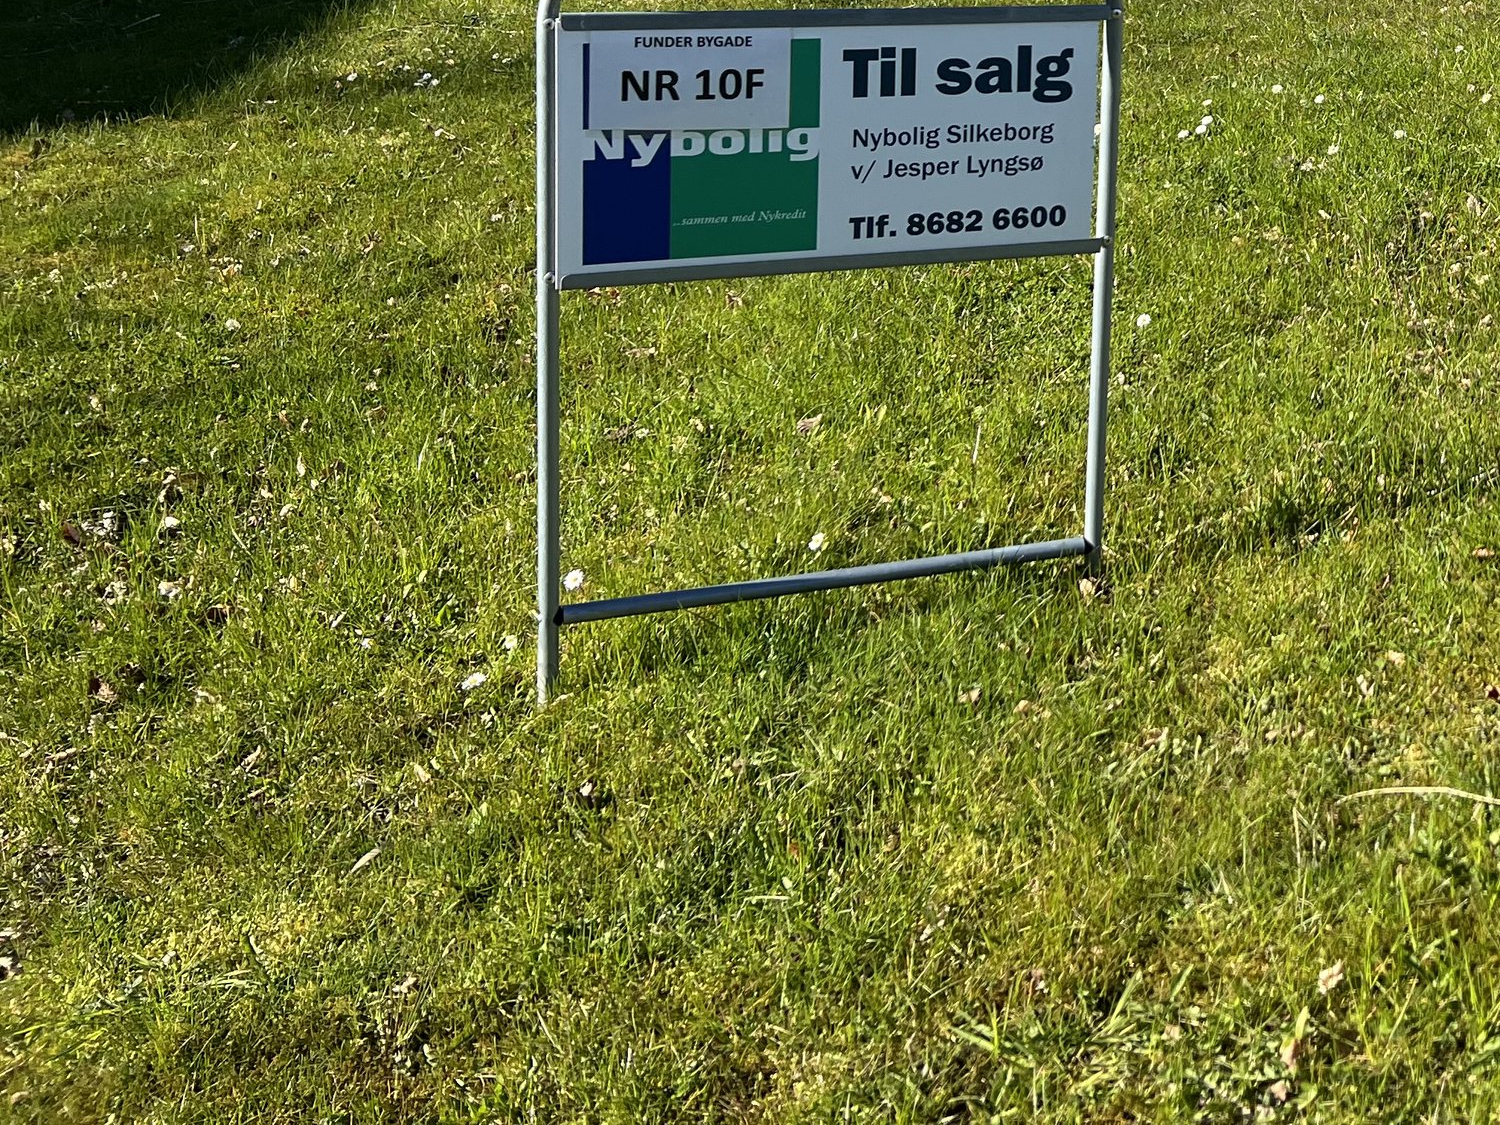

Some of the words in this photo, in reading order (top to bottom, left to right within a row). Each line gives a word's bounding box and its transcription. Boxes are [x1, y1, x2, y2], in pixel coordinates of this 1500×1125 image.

[634, 36, 693, 48] FUNDER
[697, 35, 753, 47] BYGADE
[620, 70, 680, 101] NR
[695, 68, 765, 101] 10F
[842, 46, 917, 98] Til
[935, 45, 1075, 103] salg
[852, 126, 940, 152] Nybolig
[946, 122, 1055, 144] Silkeborg
[851, 159, 877, 184] v/
[883, 158, 960, 180] Jesper
[967, 155, 1043, 178] Lyngsø
[731, 211, 755, 223] med
[757, 208, 806, 222] Nykredit
[849, 214, 897, 239] Tlf.
[906, 209, 983, 236] 8682
[992, 204, 1067, 230] 6600
